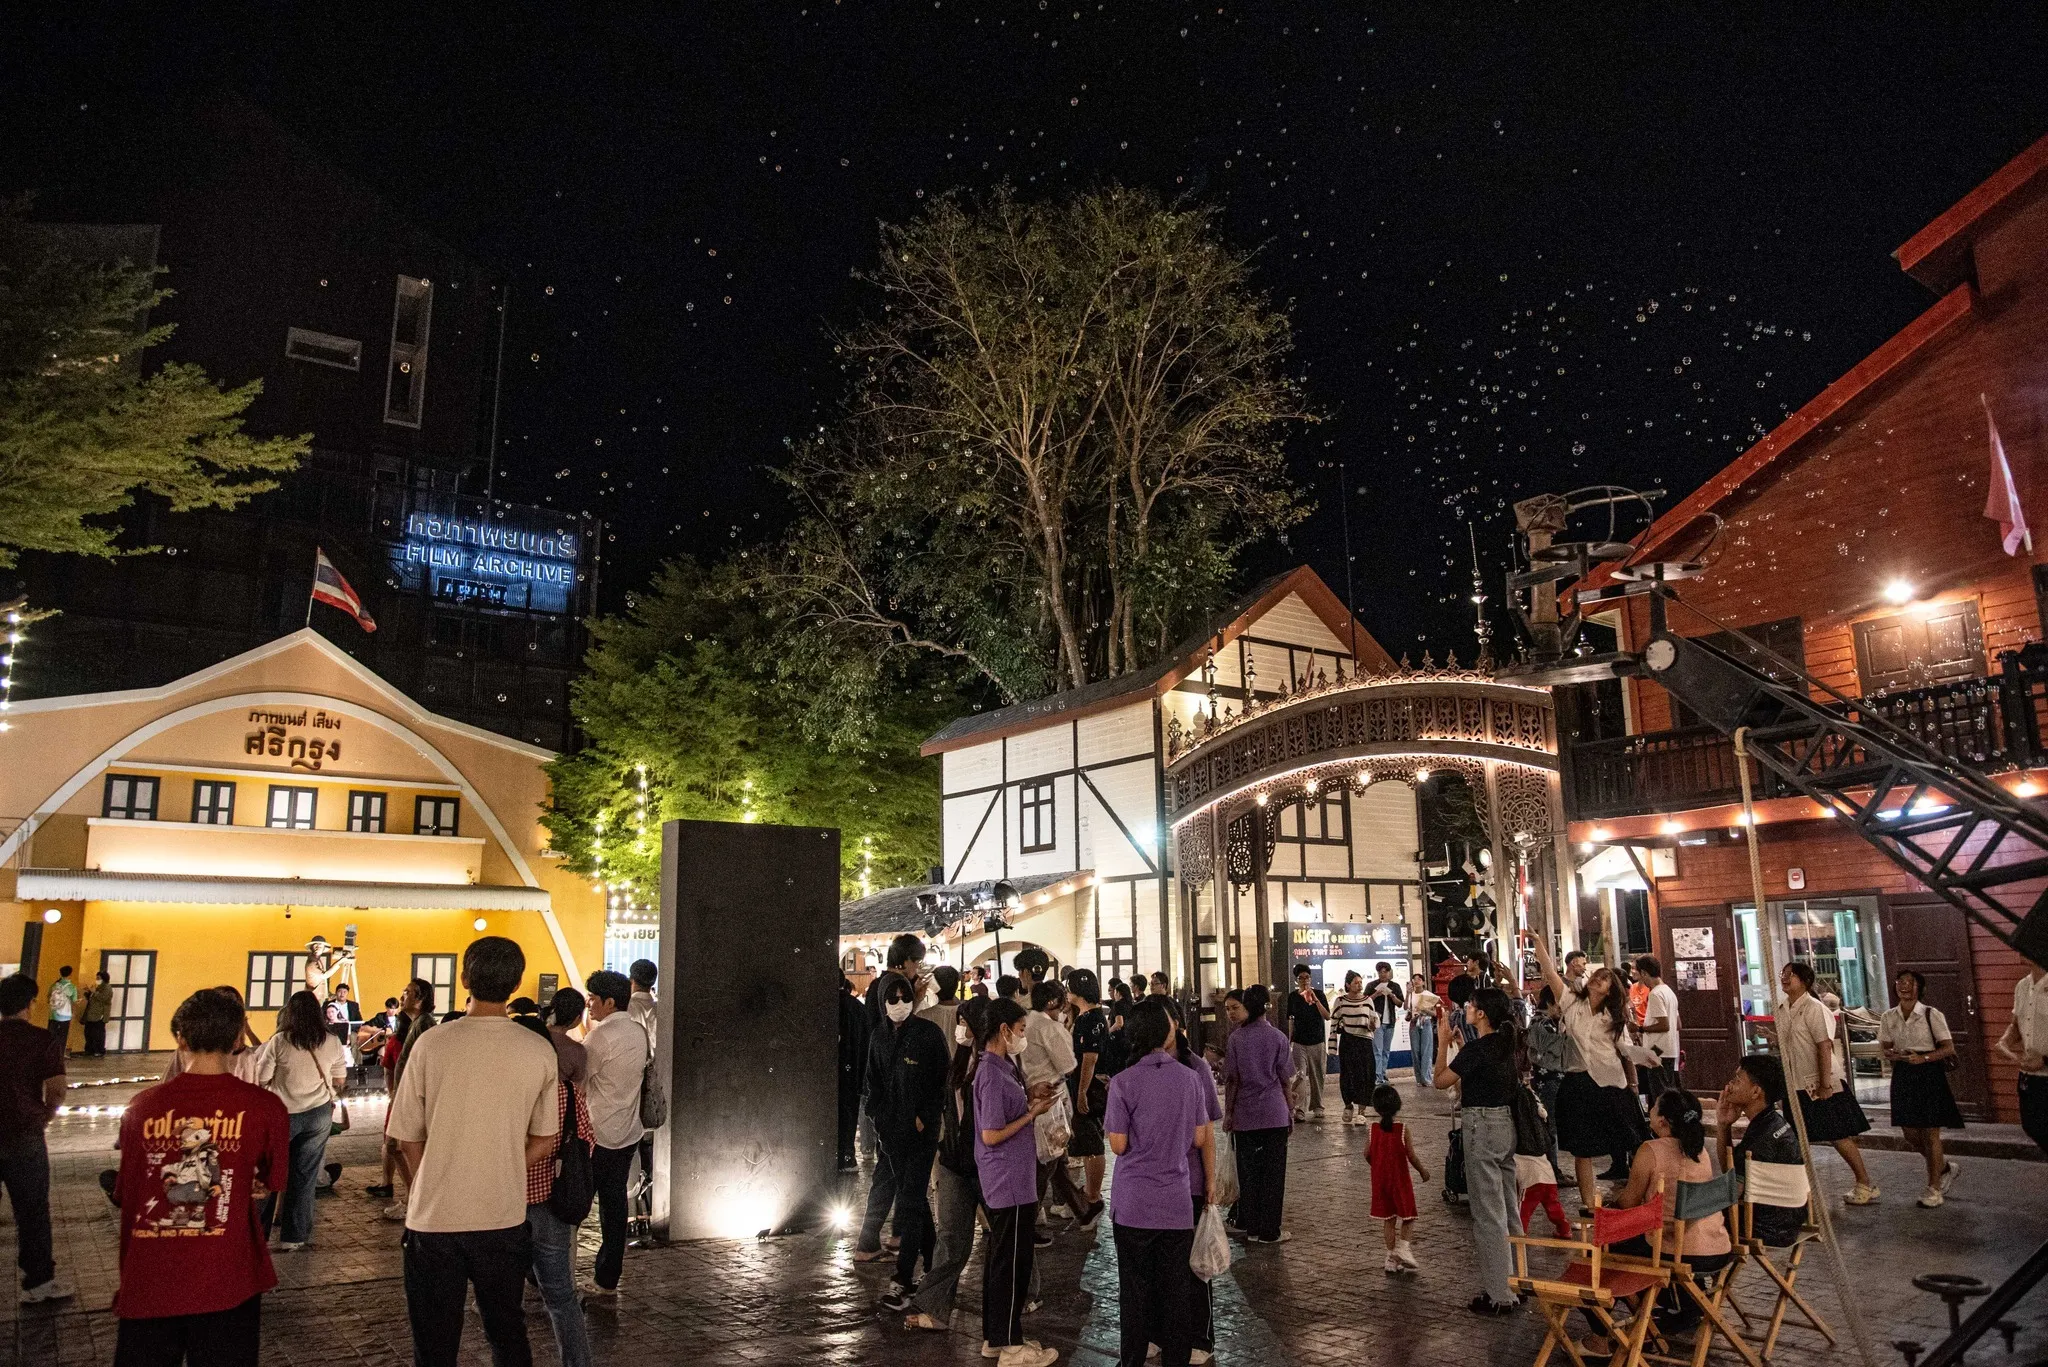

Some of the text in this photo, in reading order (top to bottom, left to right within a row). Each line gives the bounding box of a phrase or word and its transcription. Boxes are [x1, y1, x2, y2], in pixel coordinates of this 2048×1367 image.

[409, 514, 577, 559] หอภาพยนตร์
[407, 543, 572, 584] FILM ARCHIVE
[244, 725, 342, 771] ศรีกรุง
